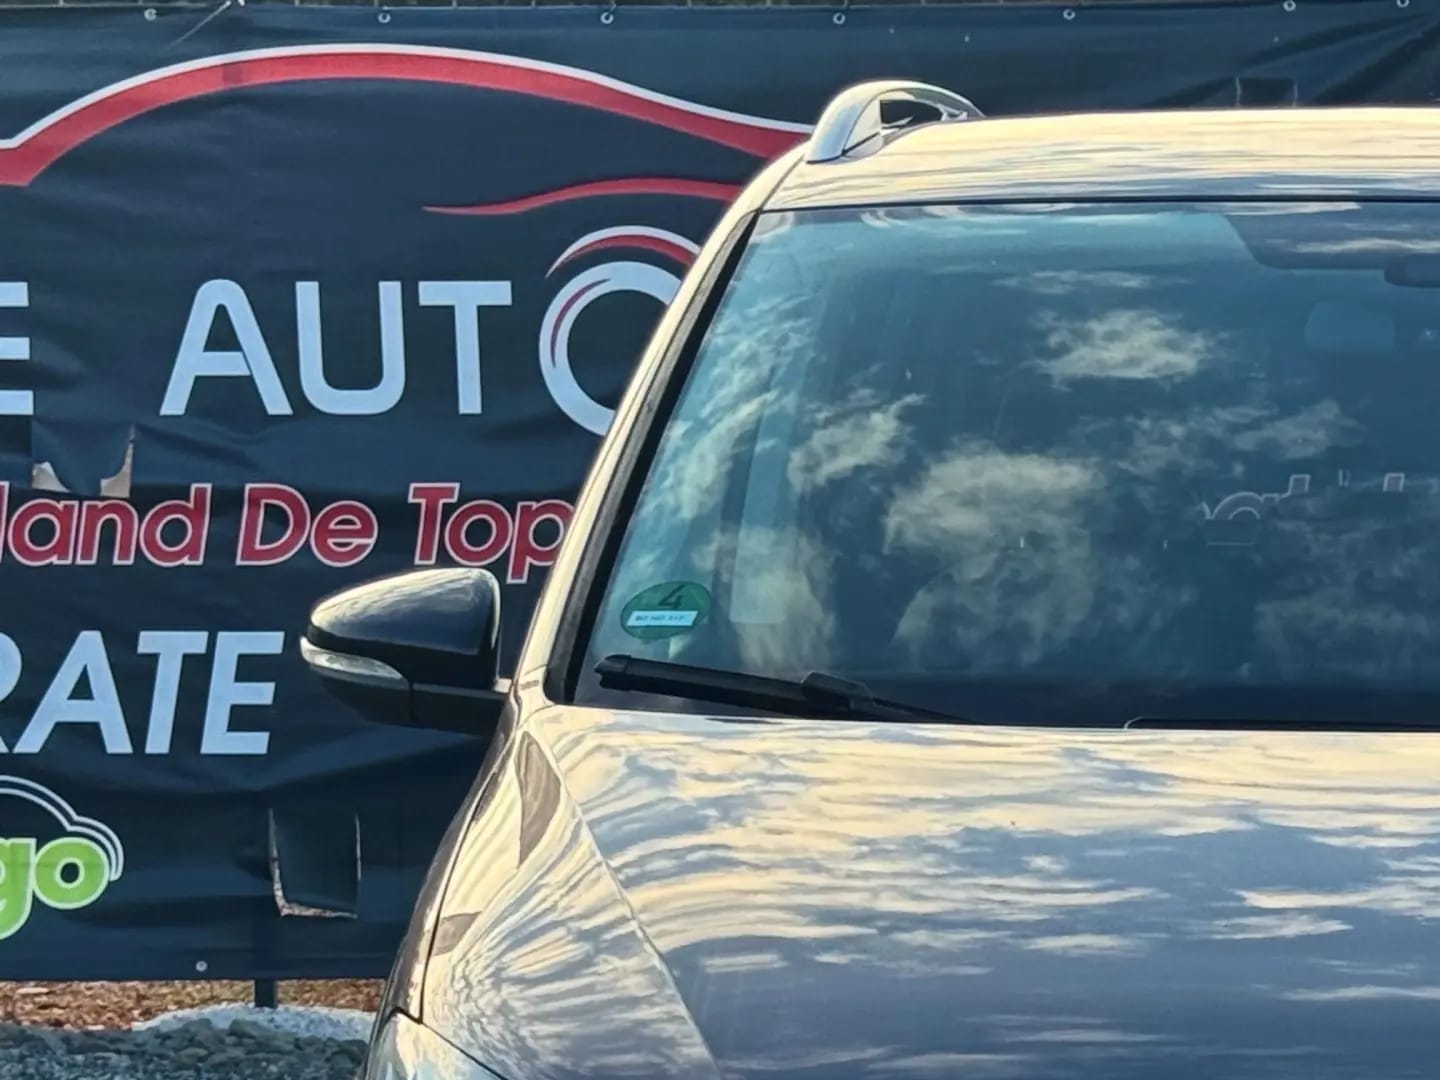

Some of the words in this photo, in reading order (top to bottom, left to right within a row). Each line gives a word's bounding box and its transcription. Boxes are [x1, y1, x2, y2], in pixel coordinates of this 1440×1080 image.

[160, 260, 686, 437] AUTO
[0, 482, 212, 567] and
[235, 482, 379, 567] De
[407, 482, 578, 584] Top
